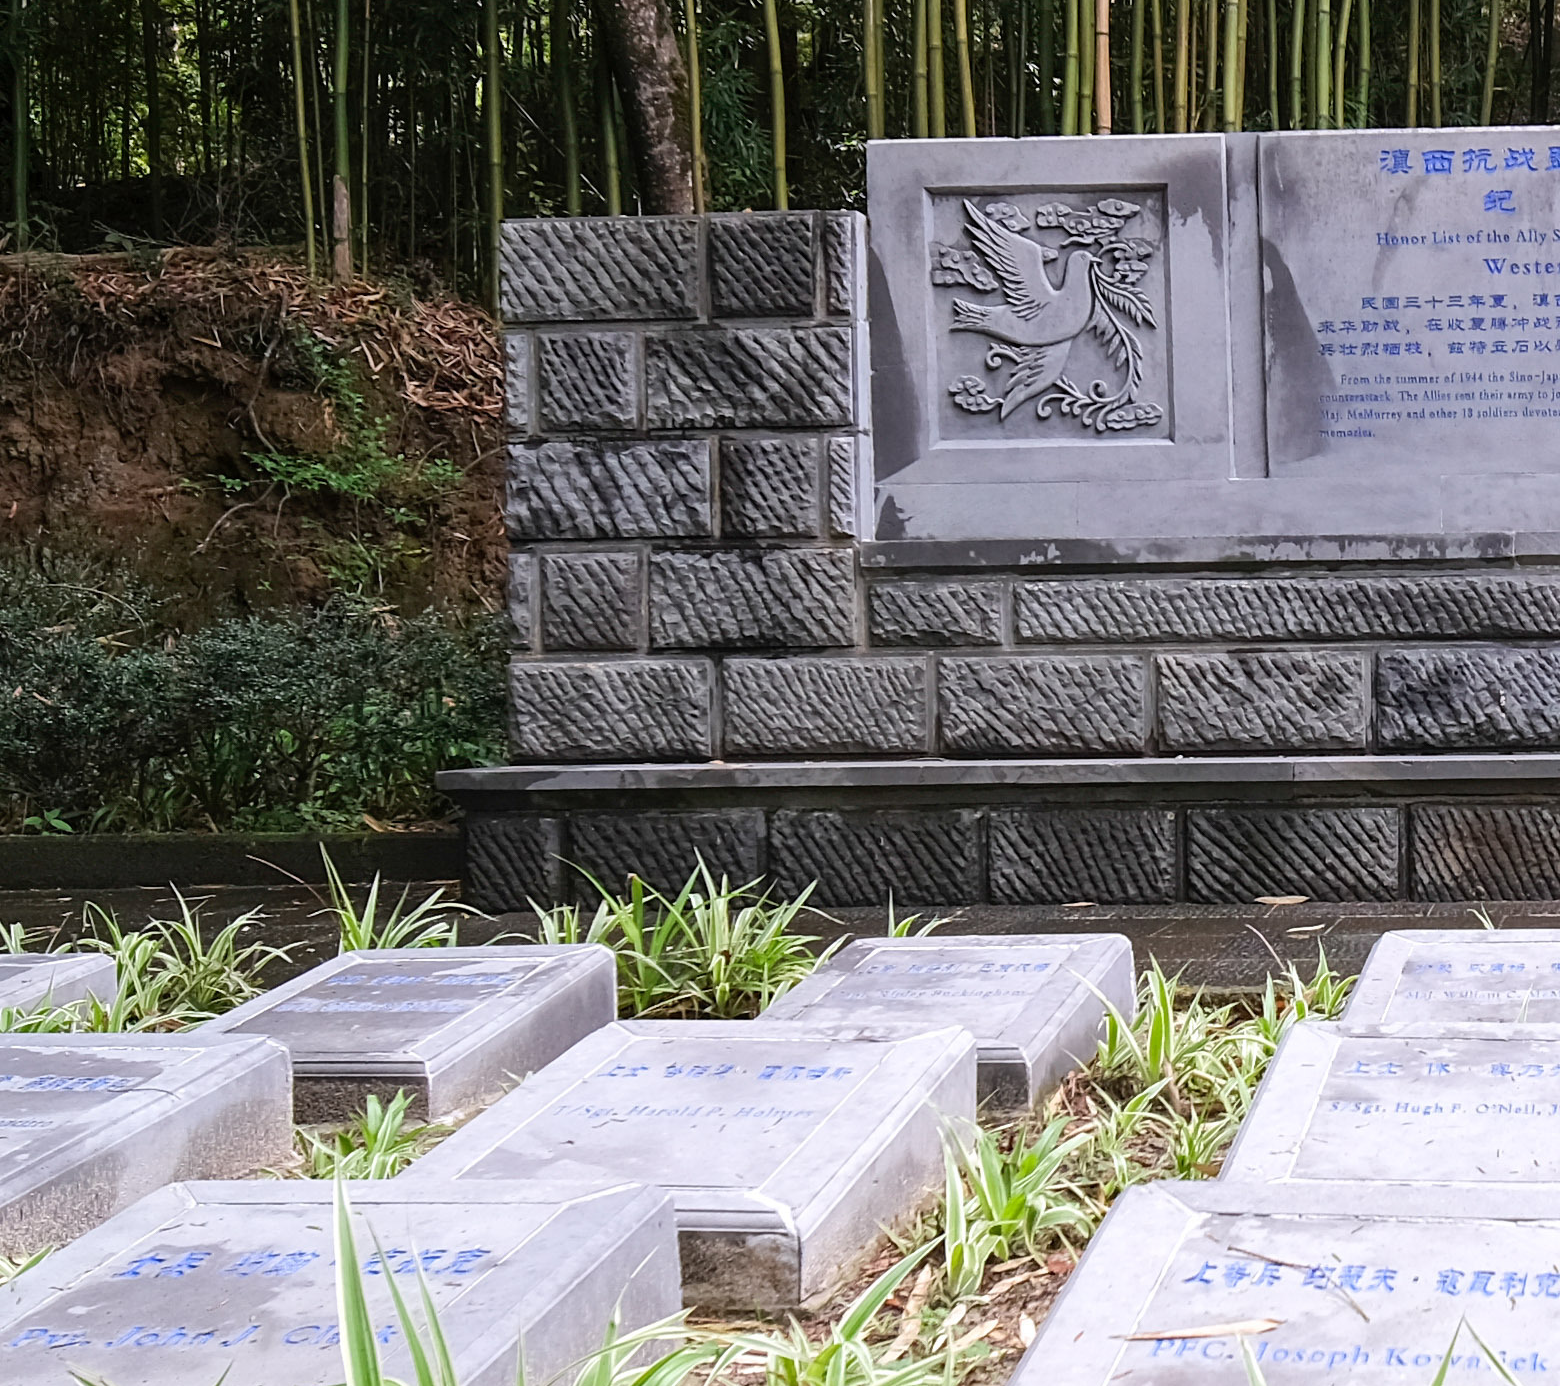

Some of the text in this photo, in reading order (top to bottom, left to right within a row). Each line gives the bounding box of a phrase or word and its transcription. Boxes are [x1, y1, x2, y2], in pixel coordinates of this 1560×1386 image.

[1376, 232, 1427, 246] Honor
[1432, 231, 1461, 244] List
[1466, 229, 1483, 244] of
[1487, 229, 1510, 243] the
[1515, 228, 1547, 246] Ally
[1340, 373, 1370, 385] From
[1375, 373, 1391, 384] the
[1444, 371, 1456, 384] of
[1460, 372, 1483, 383] 1944
[1487, 371, 1505, 383] the
[1397, 390, 1418, 401] The
[1422, 390, 1451, 401] Allies
[1479, 389, 1502, 401] their
[1507, 392, 1534, 403] army
[1537, 389, 1548, 399] to
[1406, 408, 1425, 419] and
[1429, 408, 1457, 419] other
[1395, 1102, 1443, 1116] Hugh
[111, 1250, 212, 1279] 士兵
[104, 1325, 217, 1348] John
[1147, 1339, 1234, 1361] PFC.
[1254, 1340, 1370, 1369] Joseph
